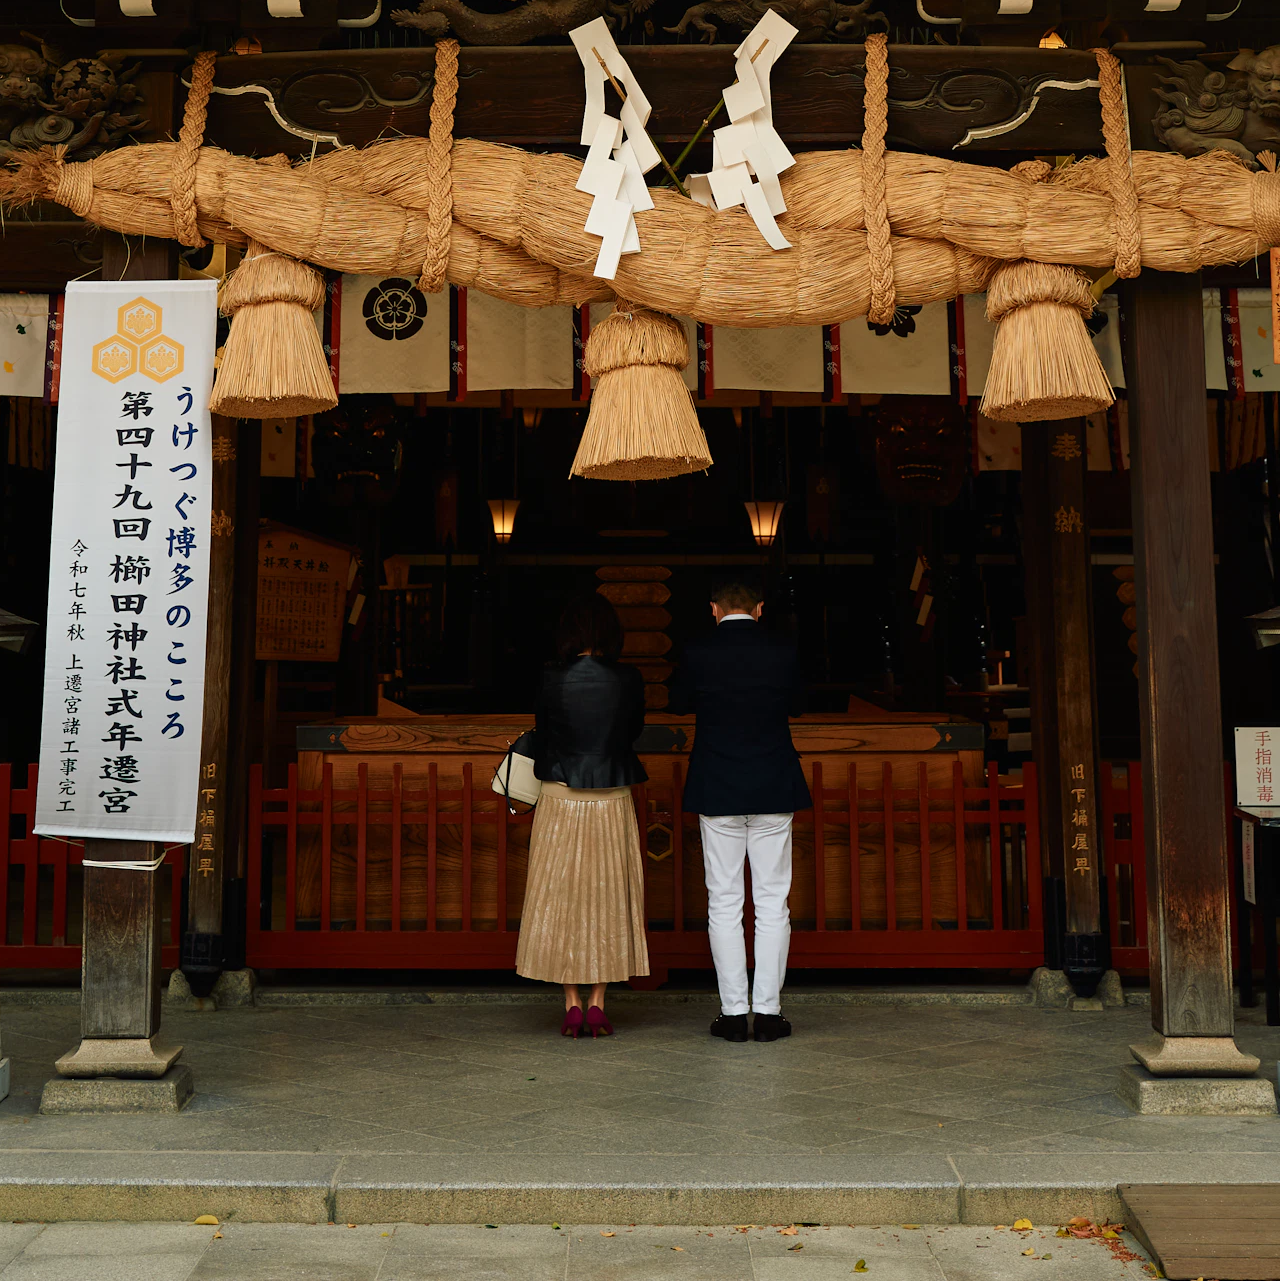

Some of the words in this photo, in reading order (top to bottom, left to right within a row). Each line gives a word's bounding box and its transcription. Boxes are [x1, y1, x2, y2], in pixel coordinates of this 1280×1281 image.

[160, 385, 199, 740] うけつぐ博多のこころ
[1255, 731, 1274, 803] 手指消毒
